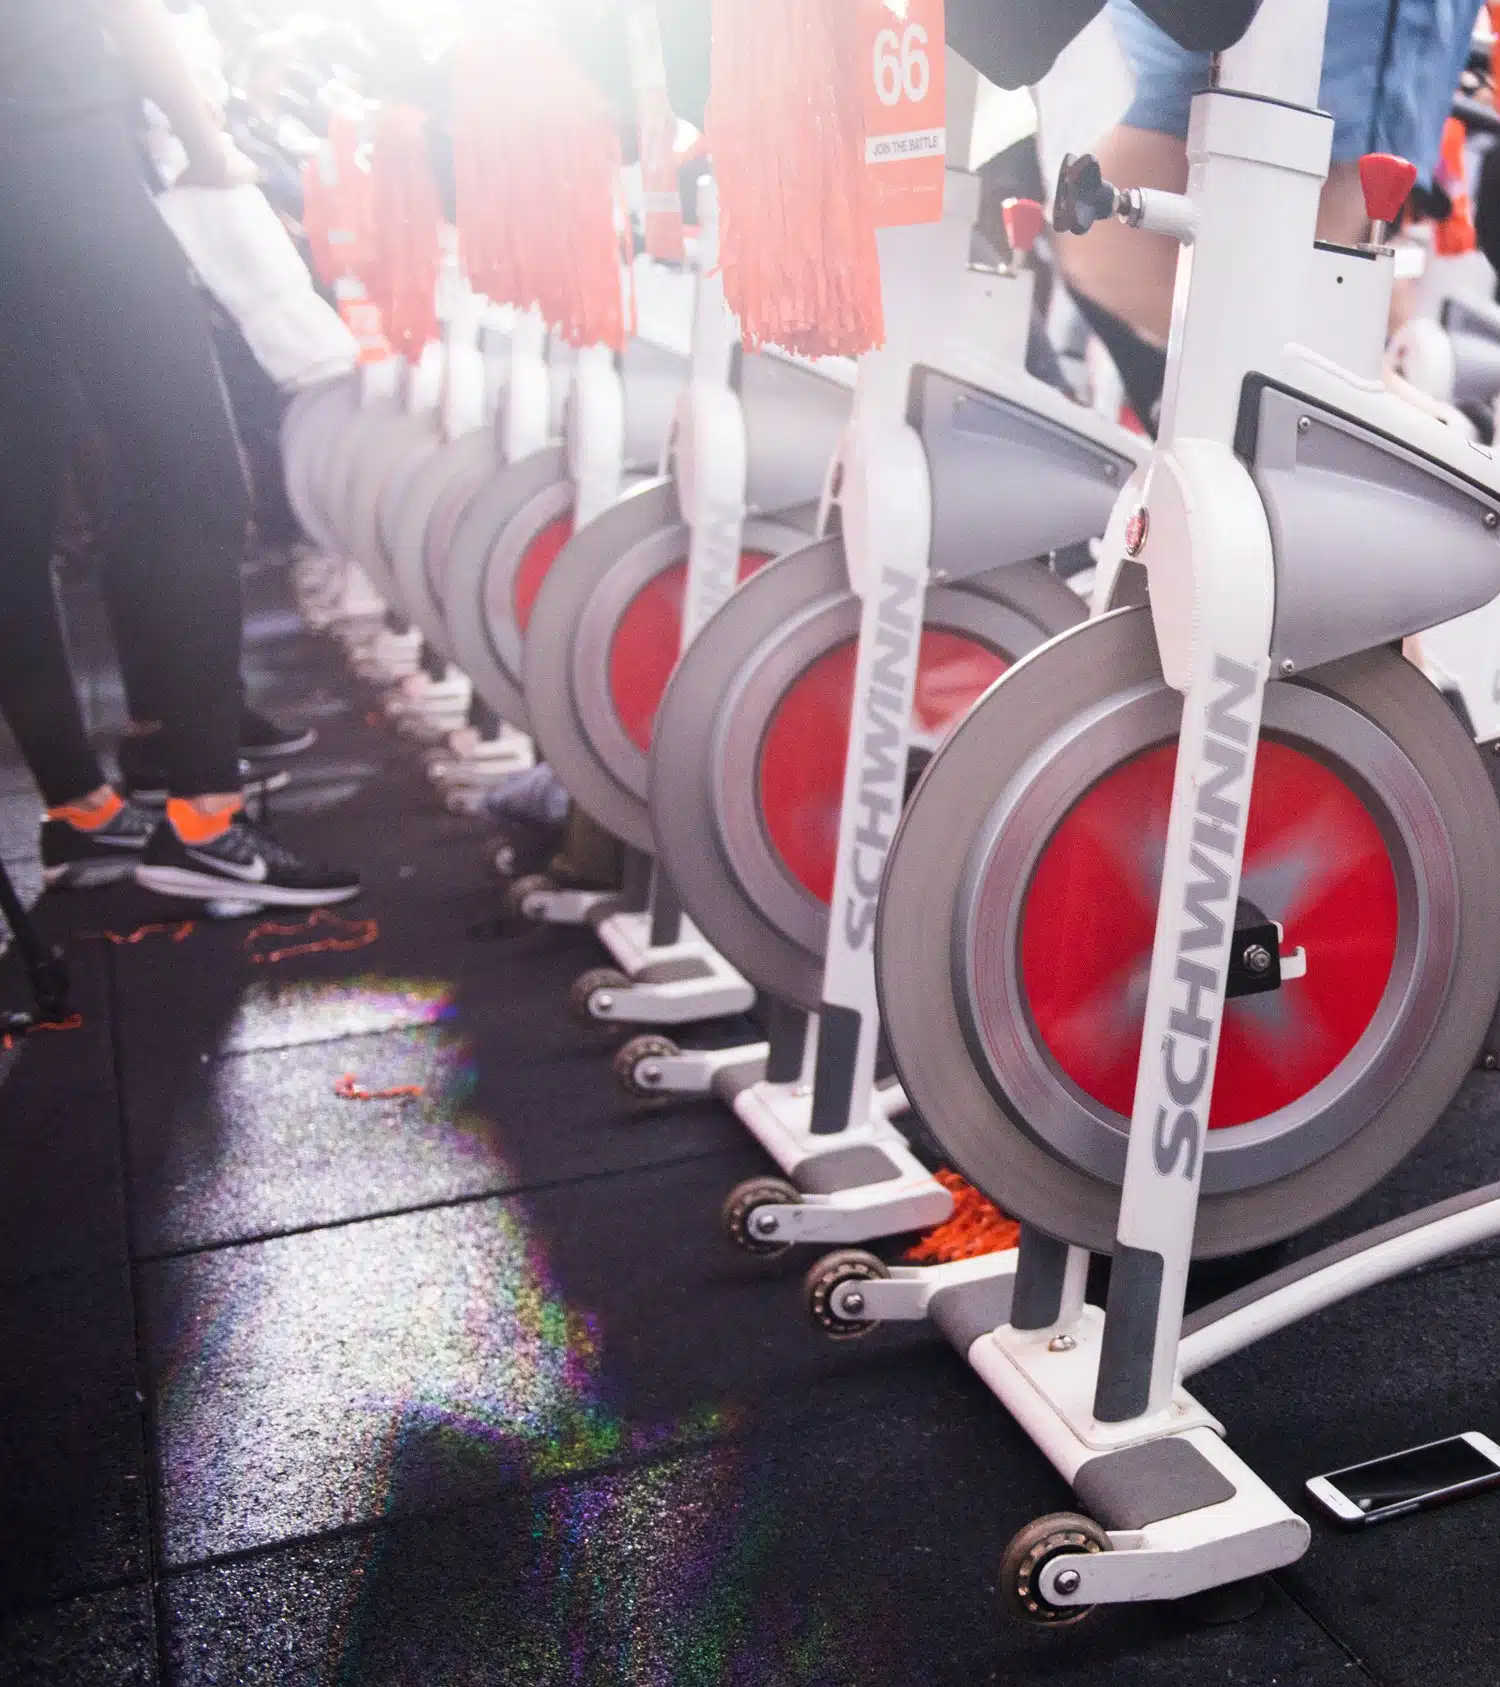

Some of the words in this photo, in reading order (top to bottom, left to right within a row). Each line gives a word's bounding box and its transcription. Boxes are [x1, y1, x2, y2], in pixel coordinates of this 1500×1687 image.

[873, 142, 890, 156] JOIN
[892, 139, 908, 153] THE
[909, 135, 938, 151] BATTLE
[874, 23, 929, 105] 66
[845, 565, 918, 951] SCHWINN
[1152, 652, 1258, 1181] SCHWINN
